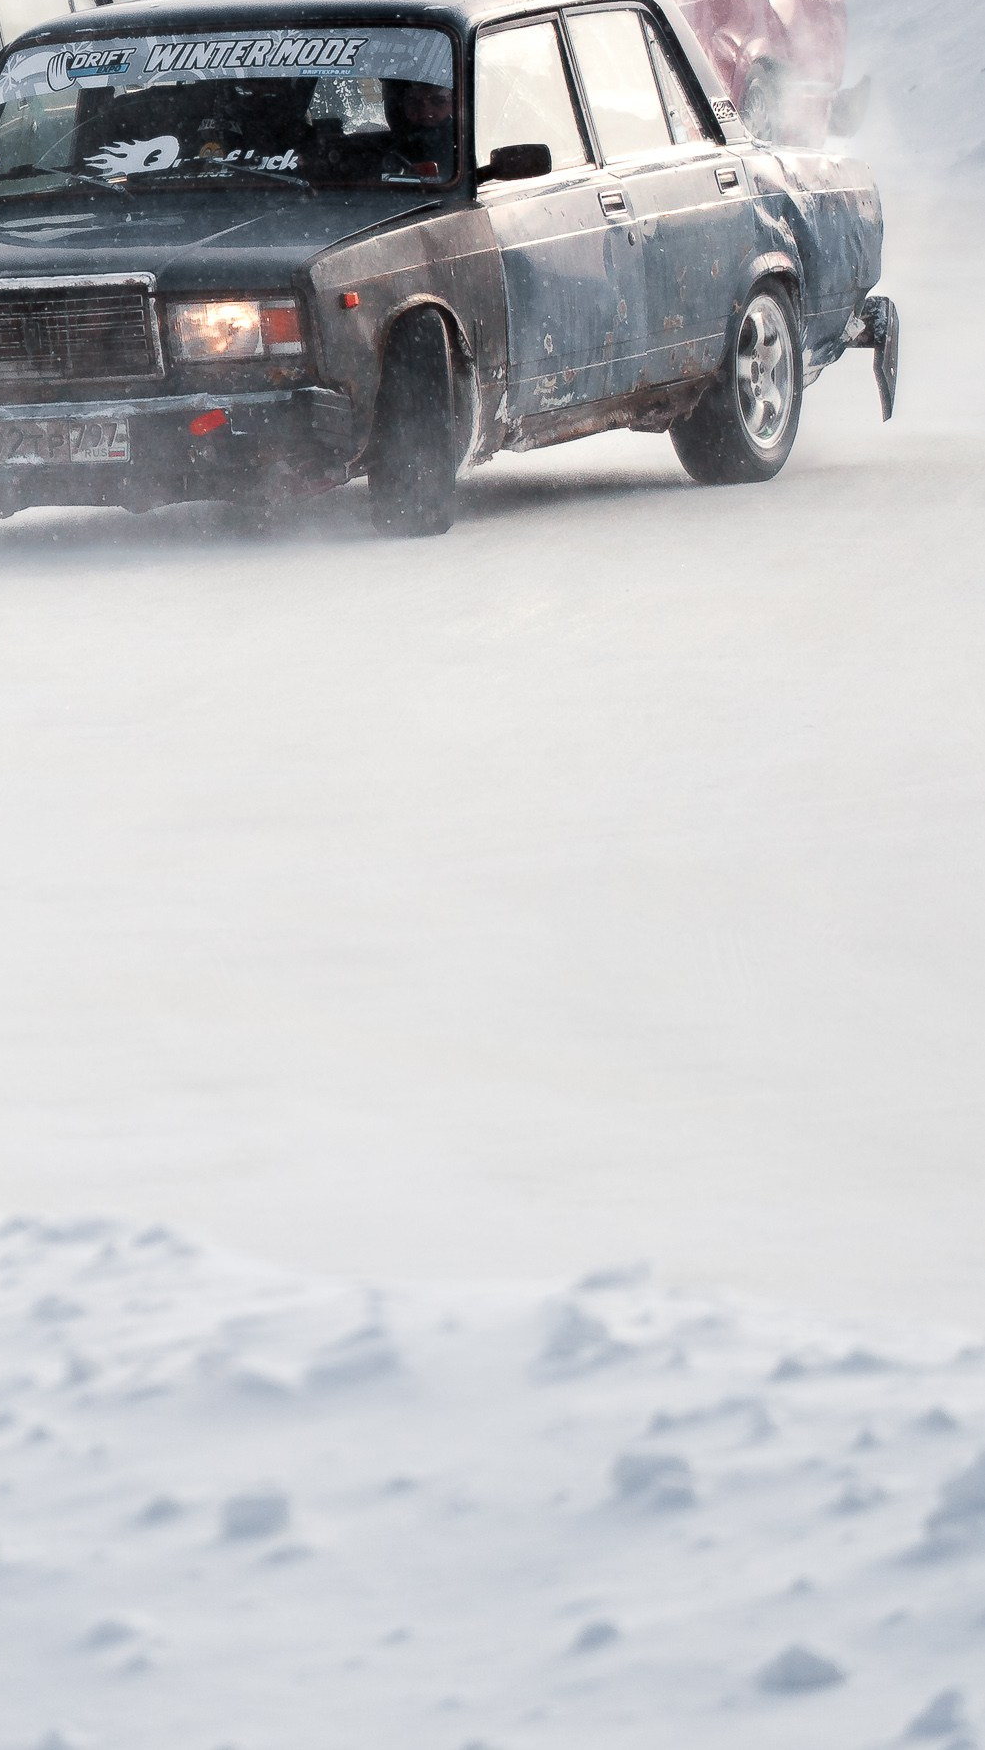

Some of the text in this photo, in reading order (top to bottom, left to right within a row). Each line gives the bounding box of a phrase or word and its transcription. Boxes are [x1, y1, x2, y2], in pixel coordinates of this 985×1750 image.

[70, 48, 137, 69] DRIFT
[144, 37, 369, 73] WINTER MODE
[96, 64, 122, 74] EXPO
[302, 68, 352, 76] DRIFTEXPO.RU
[84, 448, 108, 458] RUS
